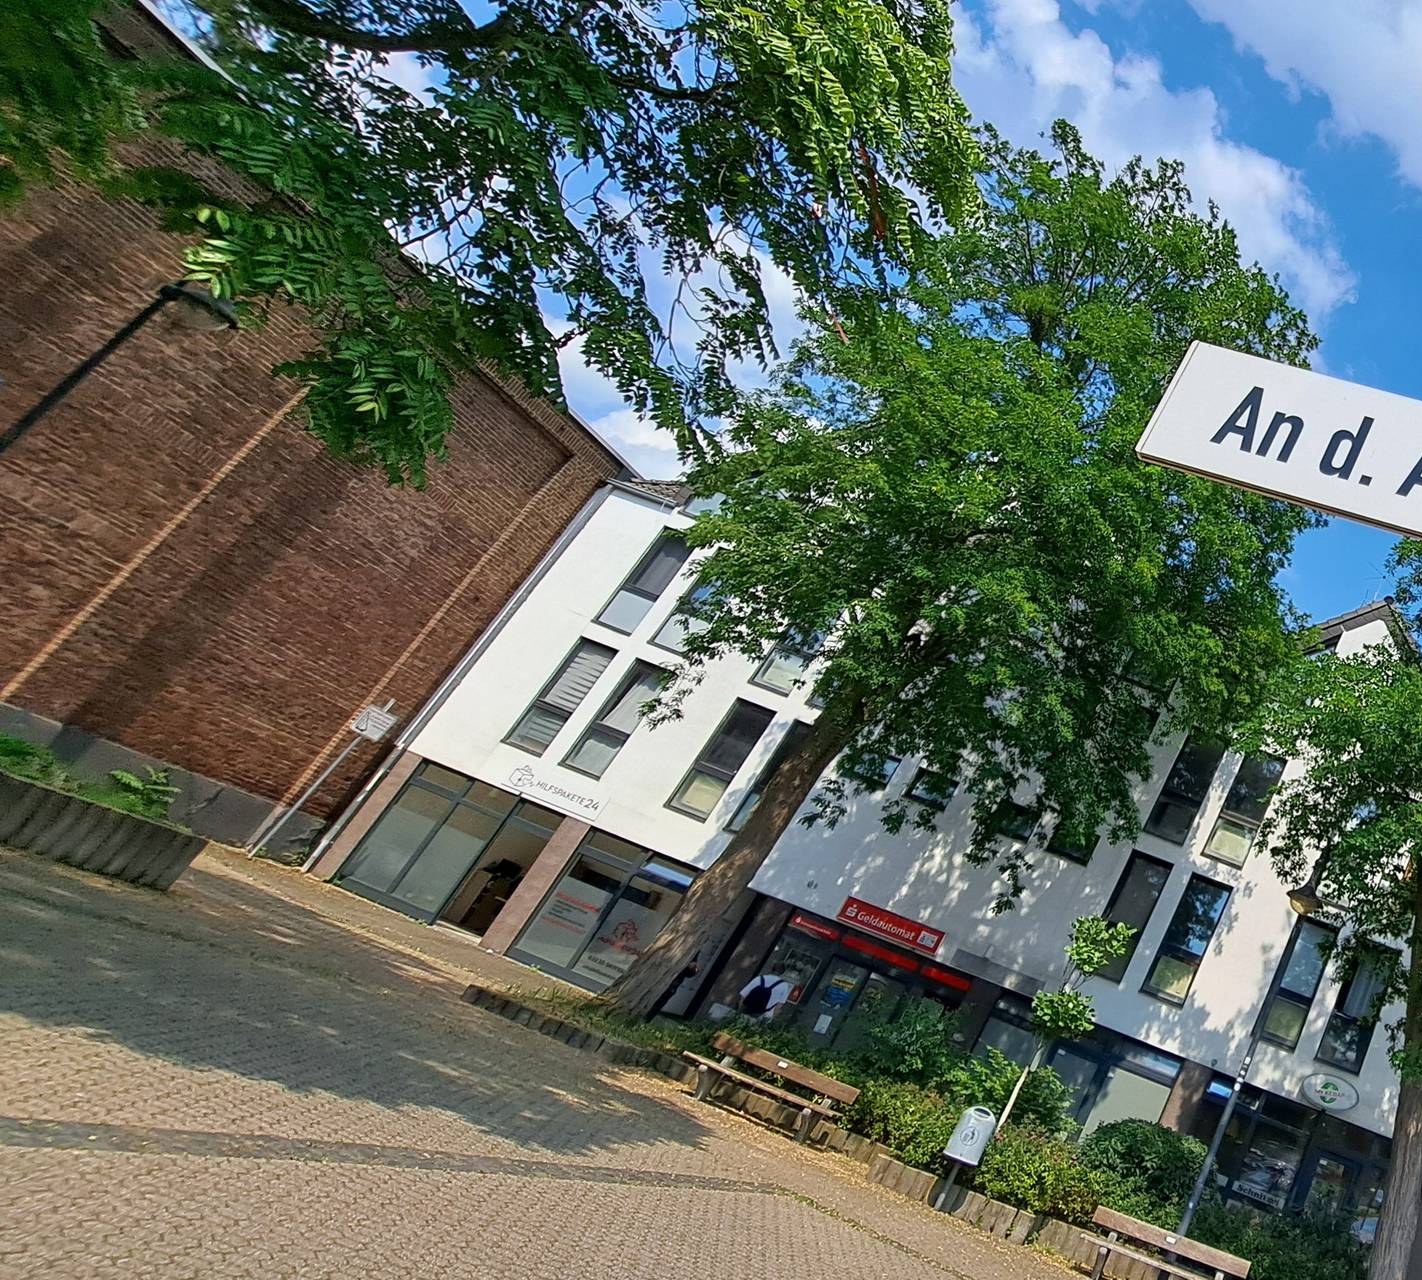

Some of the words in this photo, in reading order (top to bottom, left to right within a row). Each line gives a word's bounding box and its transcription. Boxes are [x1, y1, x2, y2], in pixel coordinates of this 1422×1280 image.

[1209, 385, 1304, 463] An
[1319, 415, 1375, 487] d.
[536, 780, 600, 811] HILFSPAKETE24
[857, 911, 915, 940] Geldautomat
